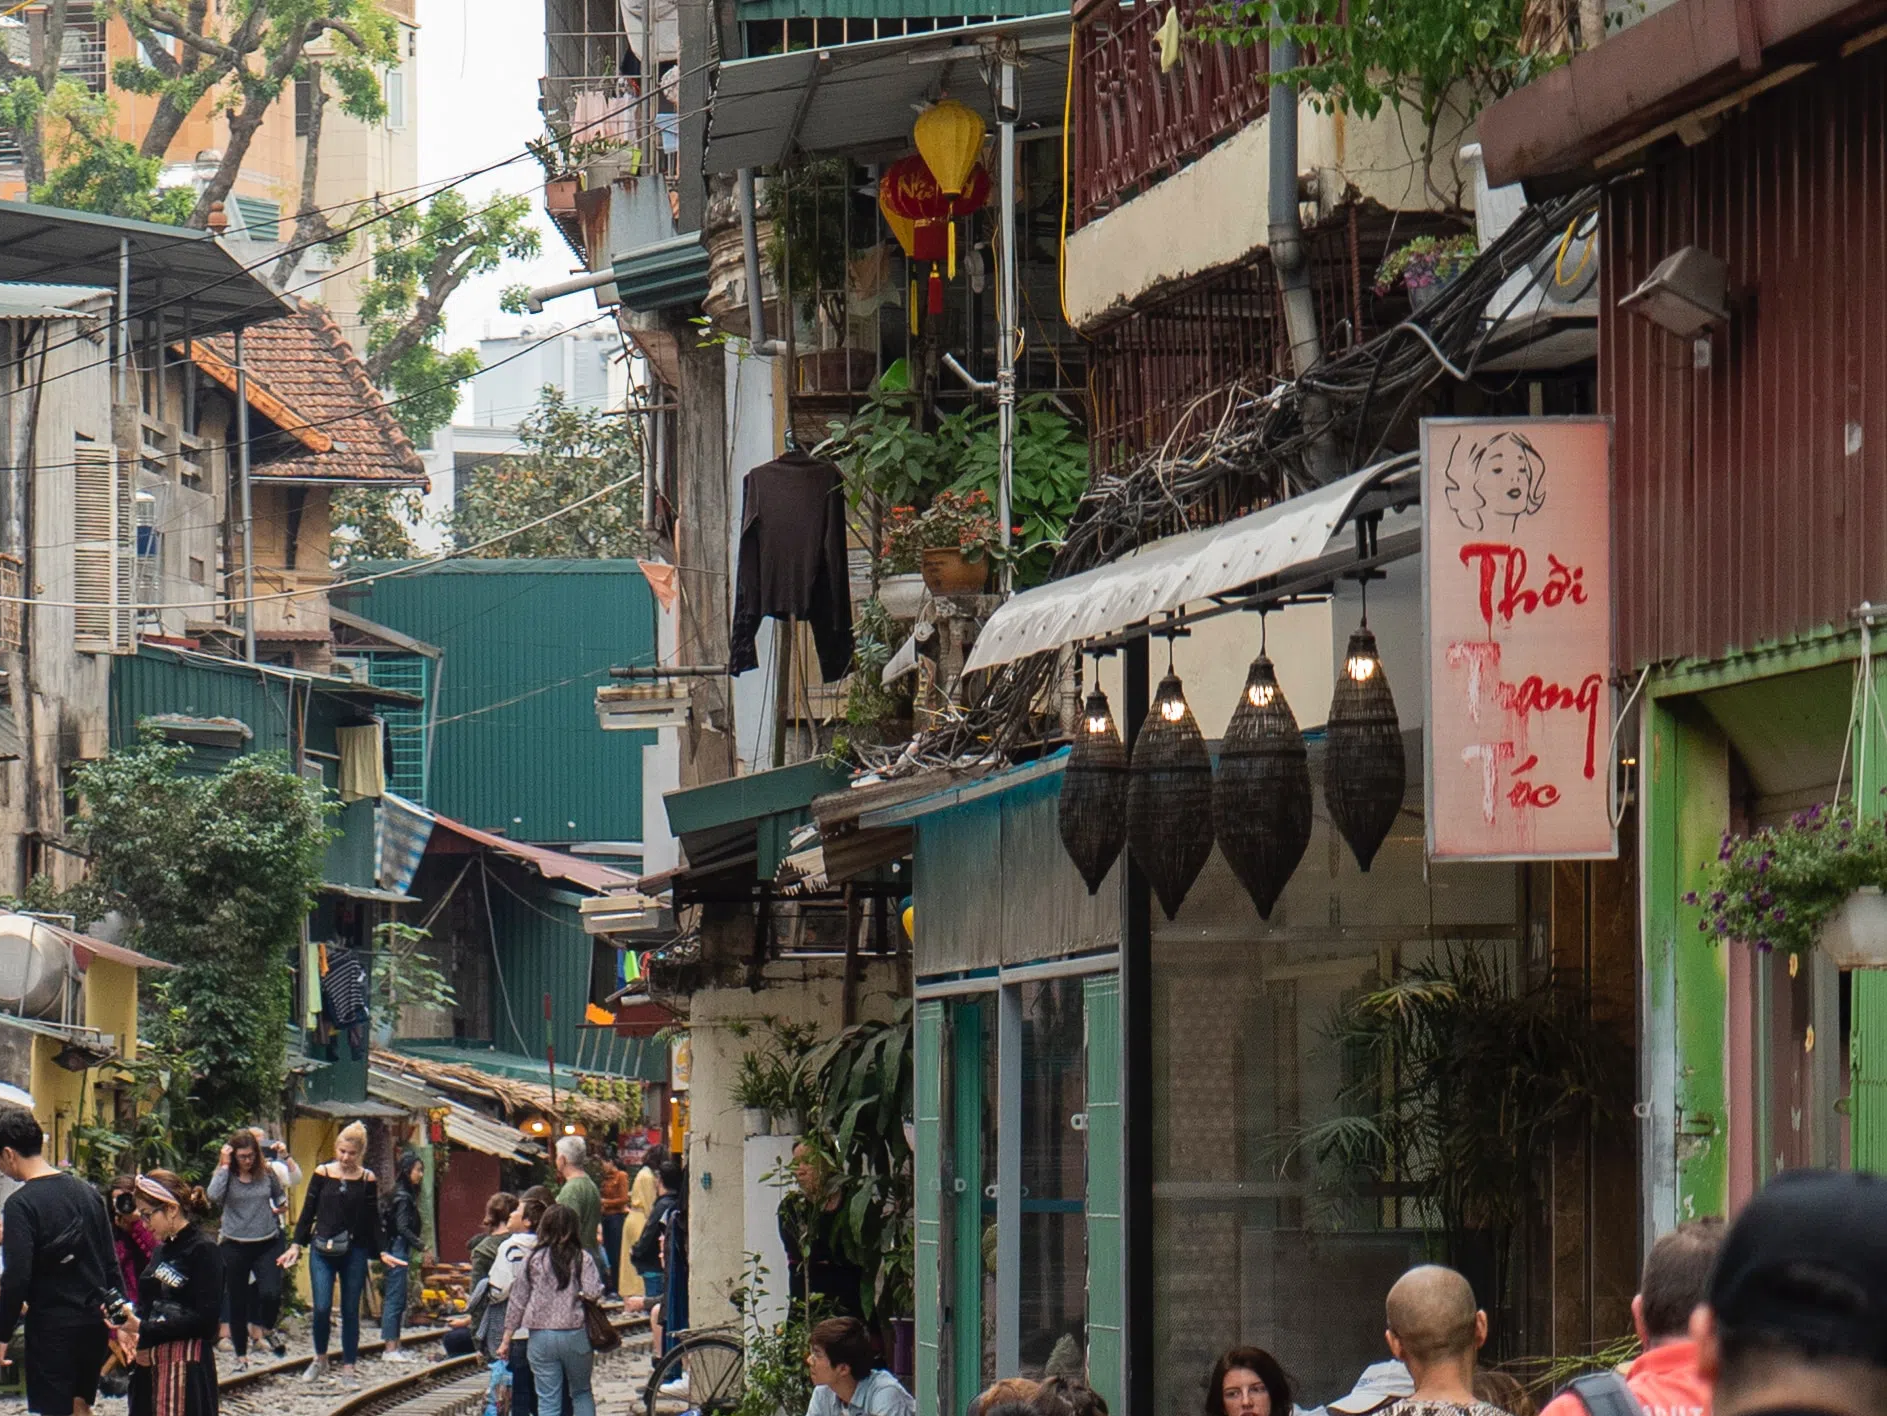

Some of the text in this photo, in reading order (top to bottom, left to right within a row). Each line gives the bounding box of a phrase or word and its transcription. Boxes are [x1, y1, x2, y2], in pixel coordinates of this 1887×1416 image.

[1459, 542, 1588, 625] Thời
[1446, 641, 1603, 780] Trang
[1461, 742, 1562, 826] Tóc
